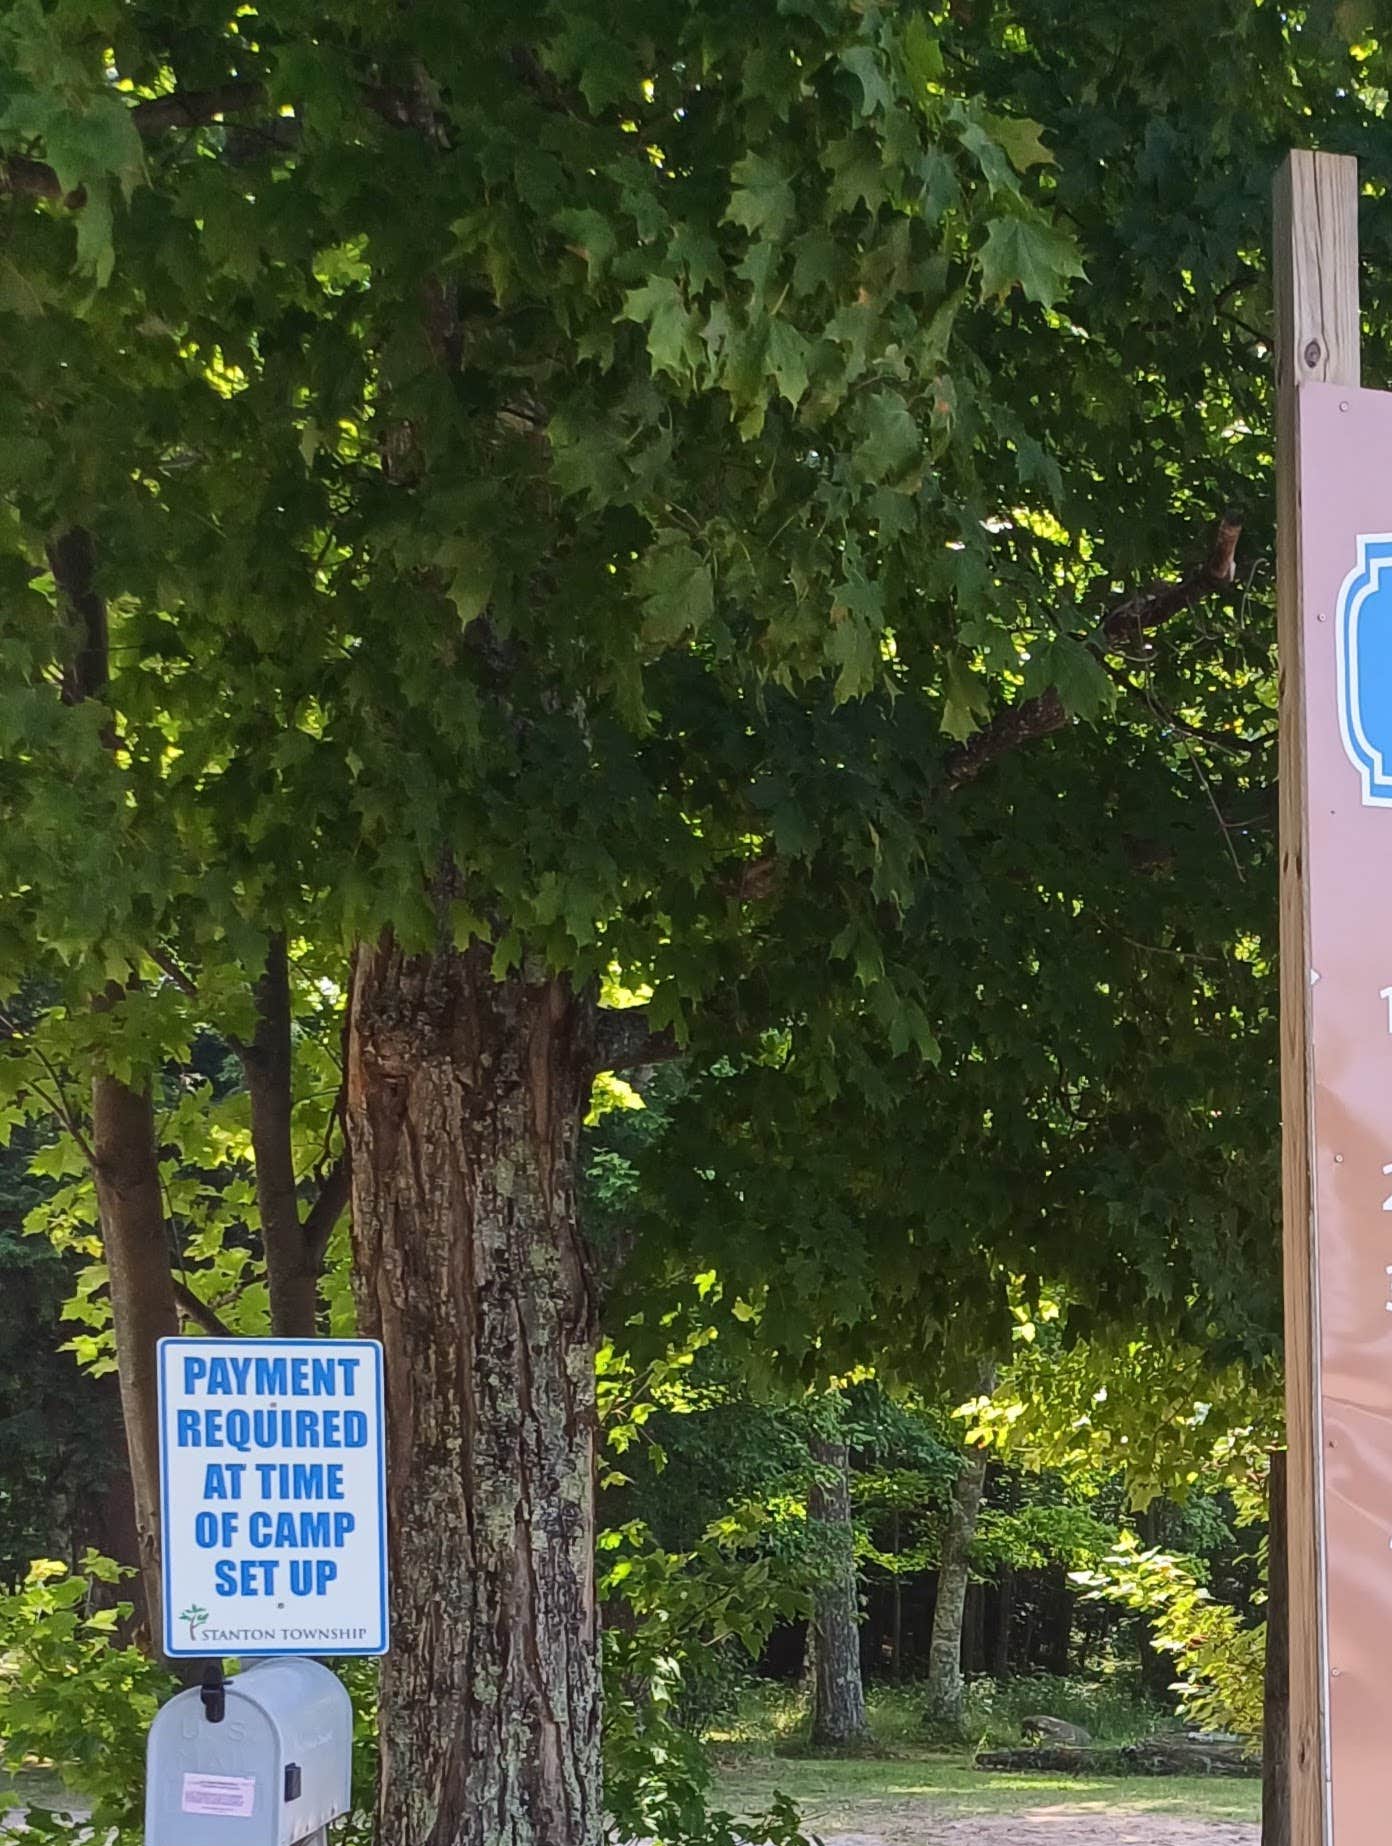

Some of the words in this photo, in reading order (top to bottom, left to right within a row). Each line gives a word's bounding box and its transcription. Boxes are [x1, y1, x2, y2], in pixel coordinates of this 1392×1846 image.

[183, 1356, 360, 1397] PAYMENT
[177, 1408, 368, 1452] REQUIRED
[203, 1463, 247, 1500] AT
[255, 1463, 345, 1500] TIME
[195, 1511, 239, 1549] OF
[249, 1511, 355, 1549] CAMP
[214, 1559, 280, 1597] SET
[289, 1559, 337, 1597] UP
[201, 1628, 276, 1641] STANTON
[279, 1628, 367, 1641] TOWNSHIP
